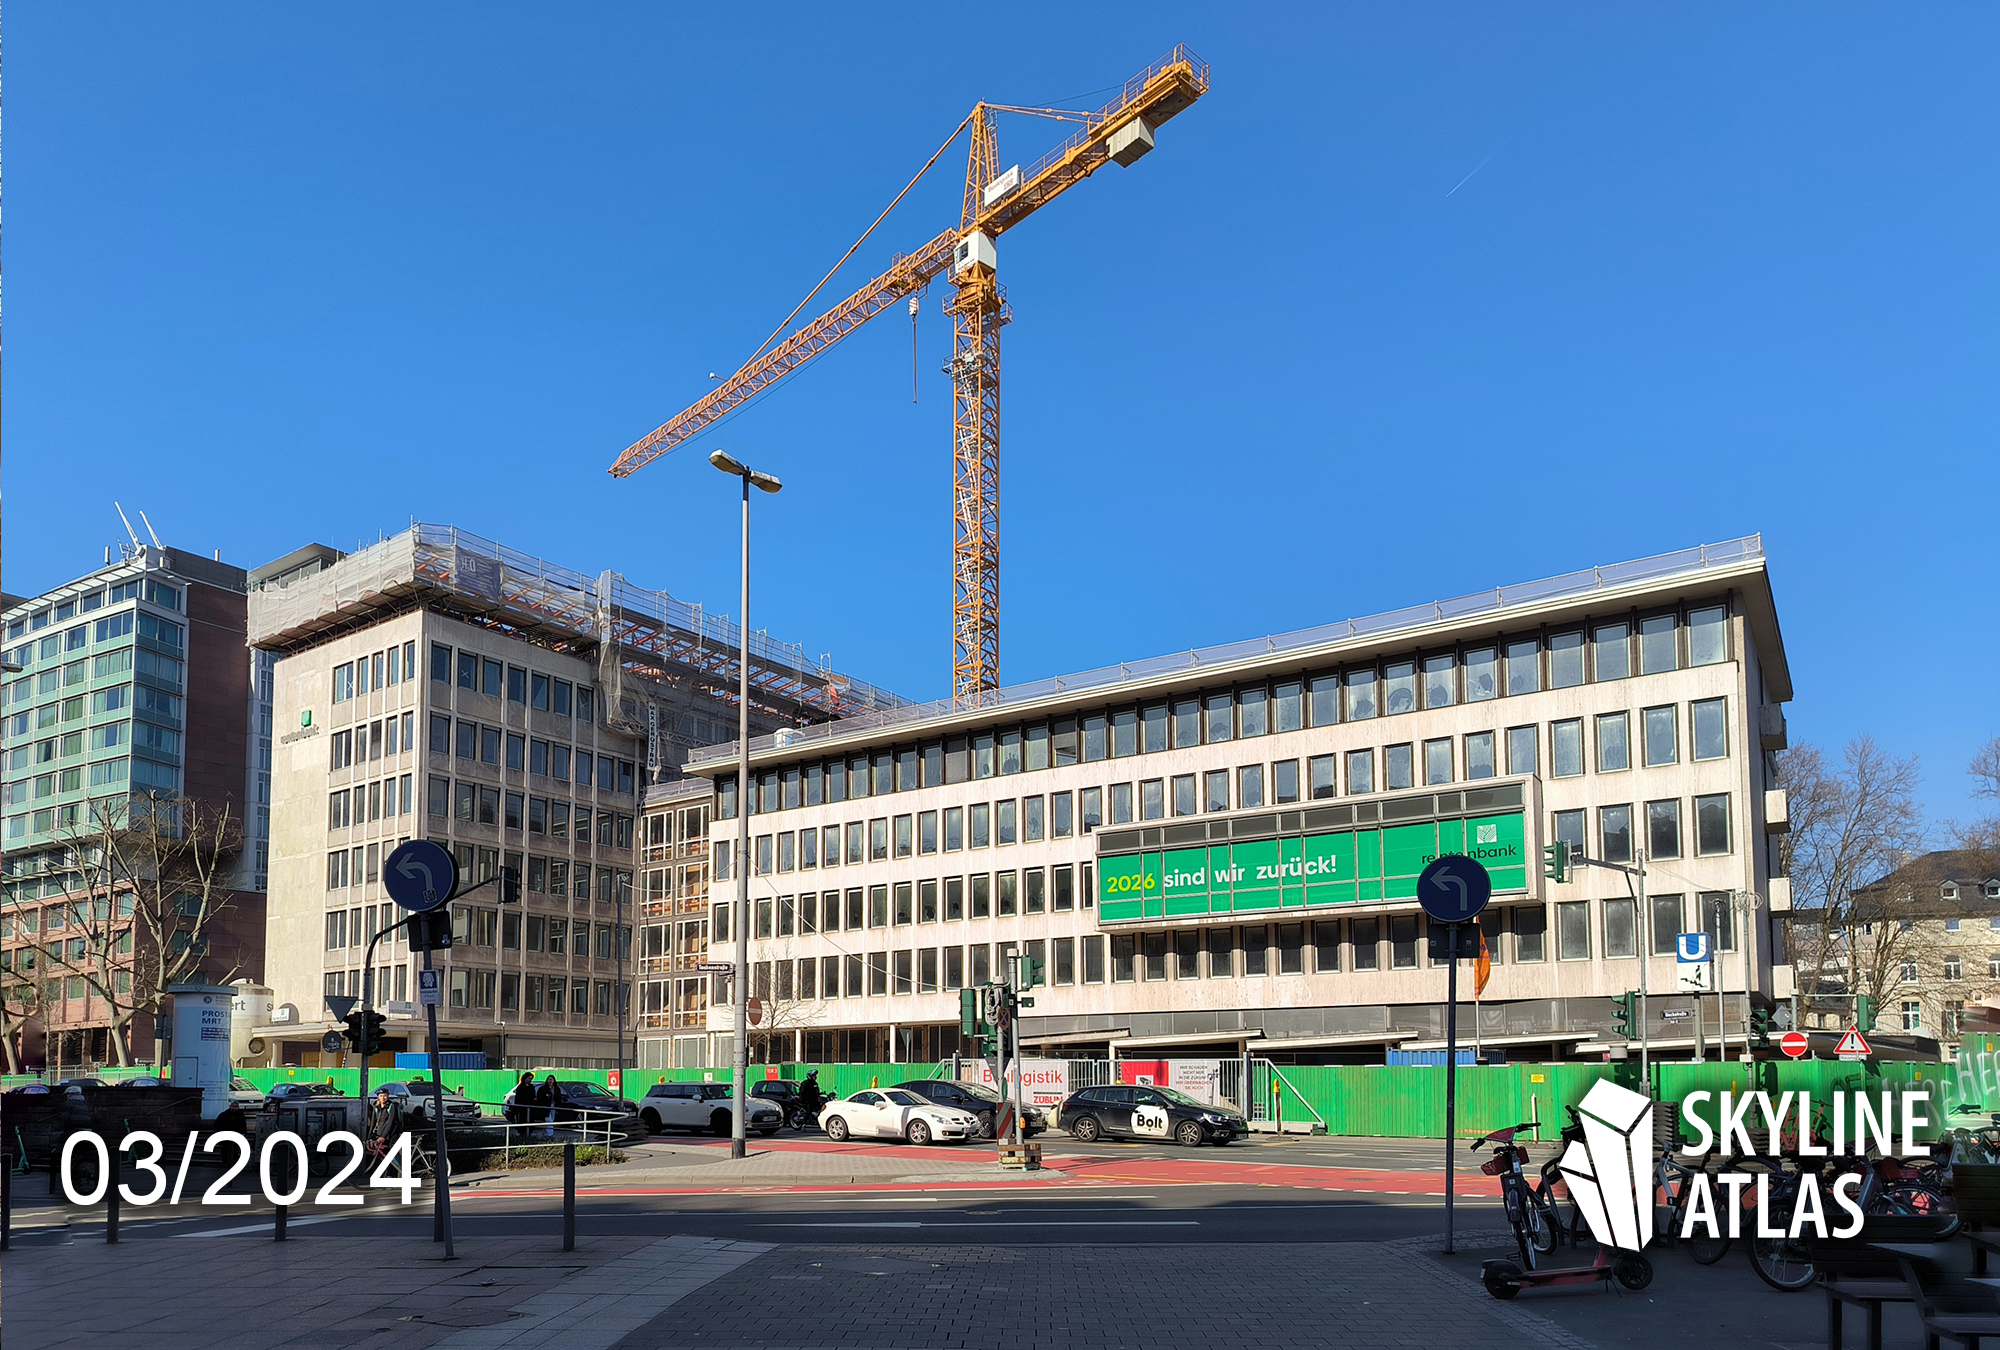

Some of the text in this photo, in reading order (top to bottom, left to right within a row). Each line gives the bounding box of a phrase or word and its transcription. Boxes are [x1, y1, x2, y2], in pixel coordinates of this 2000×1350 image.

[1107, 854, 1337, 894] 2026 sind wir zurück!
[1678, 935, 1707, 961] U
[983, 1069, 1063, 1087] Blgistik
[1136, 1113, 1163, 1131] Bolt
